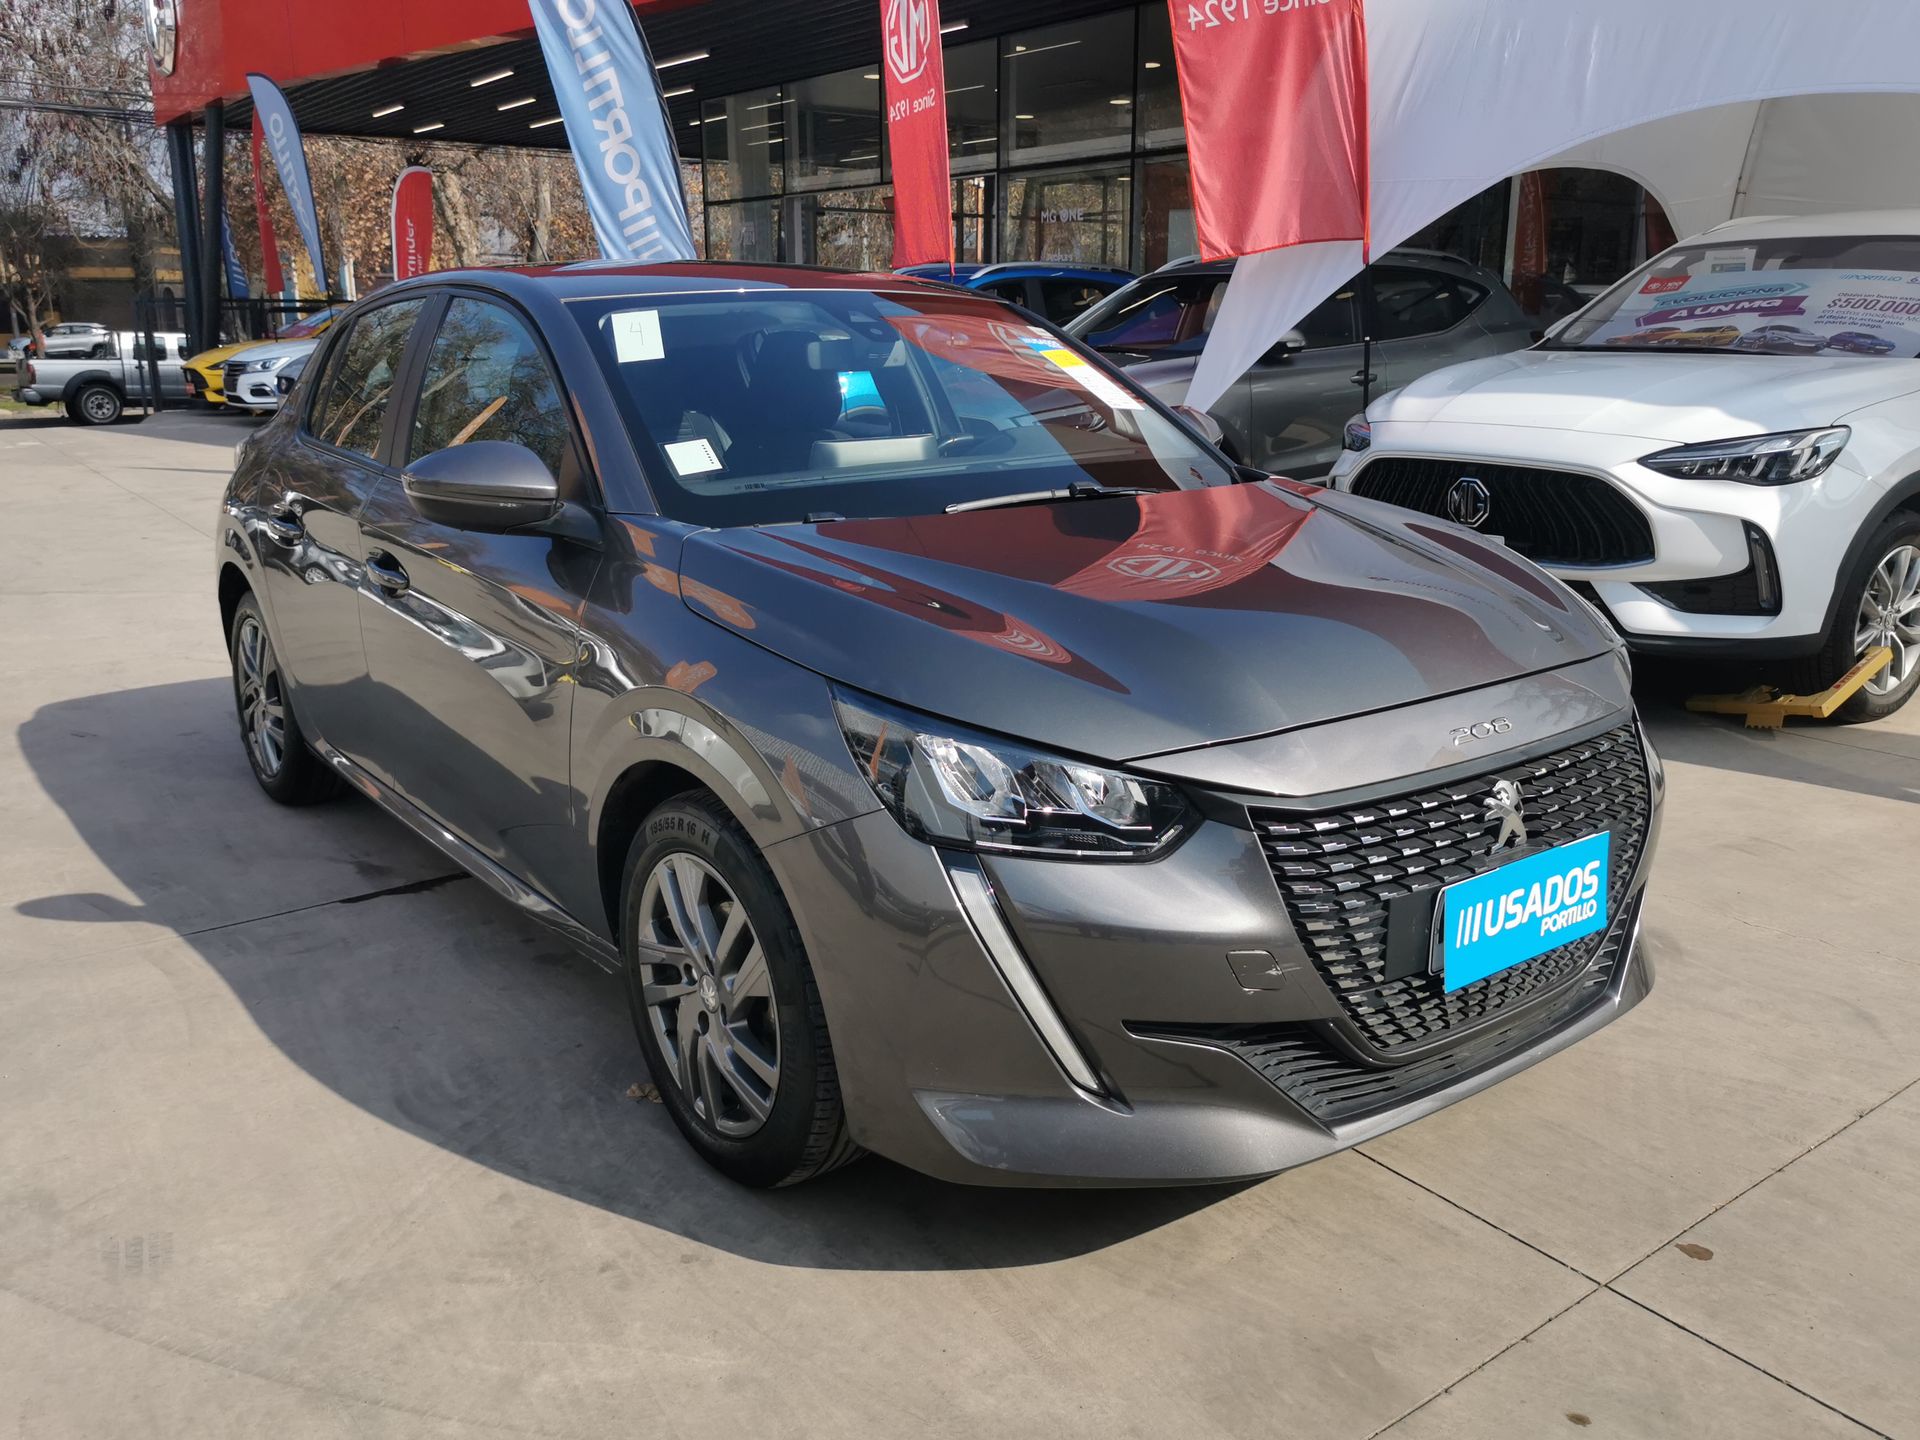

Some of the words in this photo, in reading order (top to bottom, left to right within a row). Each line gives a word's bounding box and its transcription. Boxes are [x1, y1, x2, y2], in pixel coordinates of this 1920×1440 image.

[1040, 208, 1057, 224] MG
[1059, 207, 1084, 223] ONE
[1668, 309, 1687, 319] A
[1694, 303, 1735, 315] UN
[1735, 299, 1784, 310] MG
[1827, 298, 1920, 315] $500.000
[629, 320, 644, 346] 4
[1450, 481, 1487, 523] MG
[1448, 717, 1513, 746] 208
[678, 817, 684, 832] R
[687, 820, 697, 837] 16
[701, 829, 710, 846] H
